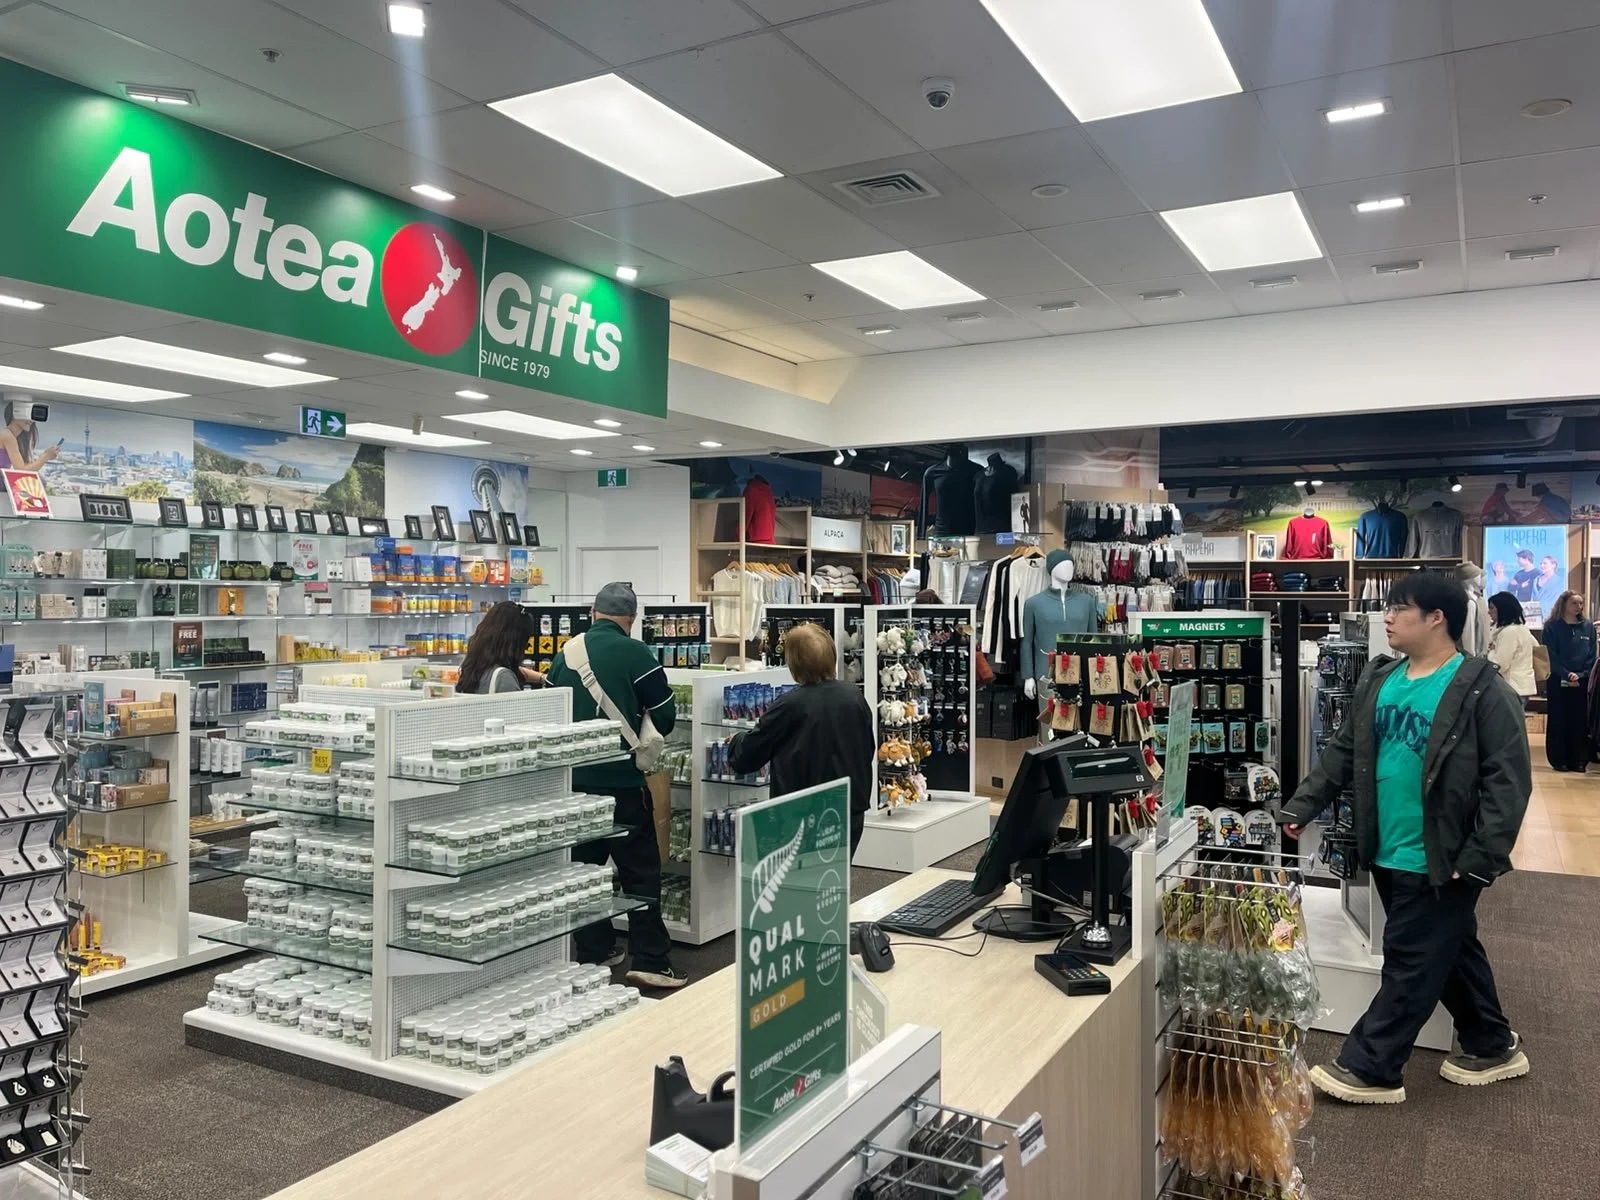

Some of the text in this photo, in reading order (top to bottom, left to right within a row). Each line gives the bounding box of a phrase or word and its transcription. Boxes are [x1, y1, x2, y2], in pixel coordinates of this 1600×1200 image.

[66, 146, 623, 373] Aotea Gifts
[480, 350, 551, 379] SINCE 1979
[824, 529, 844, 538] ALPACA
[1503, 527, 1548, 546] KAPEKA
[178, 631, 198, 639] FREE
[1179, 622, 1226, 632] MAGNETS
[748, 914, 806, 966] QUAL
[749, 944, 806, 997] MARK
[752, 993, 786, 1024] GOLD
[749, 1049, 784, 1080] CERTIFIED
[784, 1037, 802, 1057] GOLD
[802, 1028, 816, 1044] FOR
[823, 1011, 842, 1029] YEARS
[772, 1068, 823, 1112] Aotea Gifts
